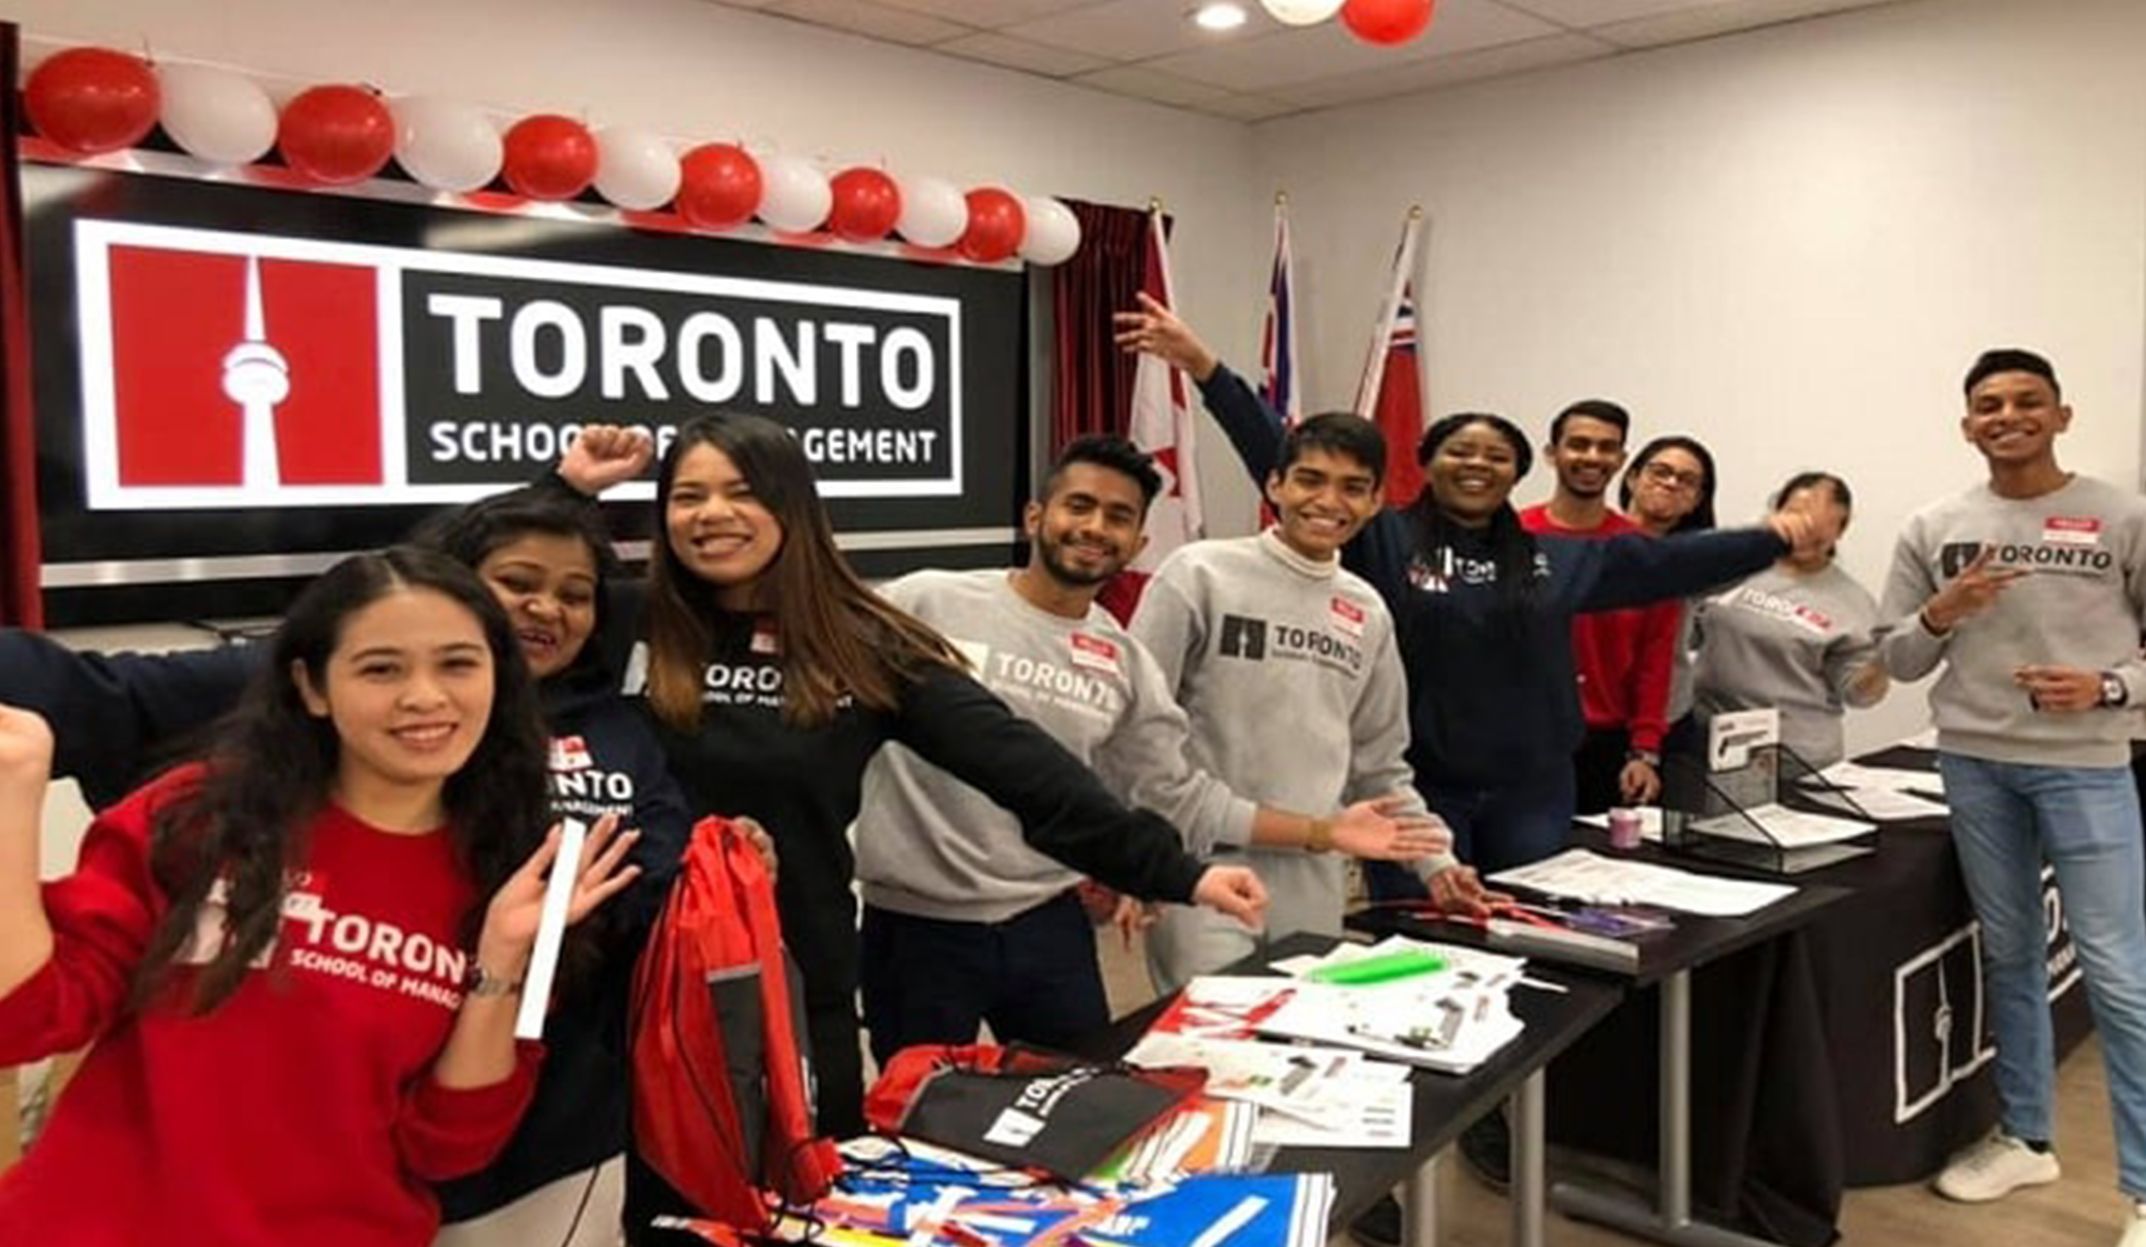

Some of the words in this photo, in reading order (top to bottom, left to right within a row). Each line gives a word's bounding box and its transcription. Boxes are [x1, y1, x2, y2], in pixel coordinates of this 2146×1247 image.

[427, 292, 935, 410] TORONTO
[799, 428, 937, 462] GEMENT
[2000, 544, 2113, 570] ORONTO
[304, 904, 467, 985] TORON
[291, 948, 370, 983] SCHOOL
[369, 969, 399, 989] OF
[399, 976, 463, 1011] MANAG
